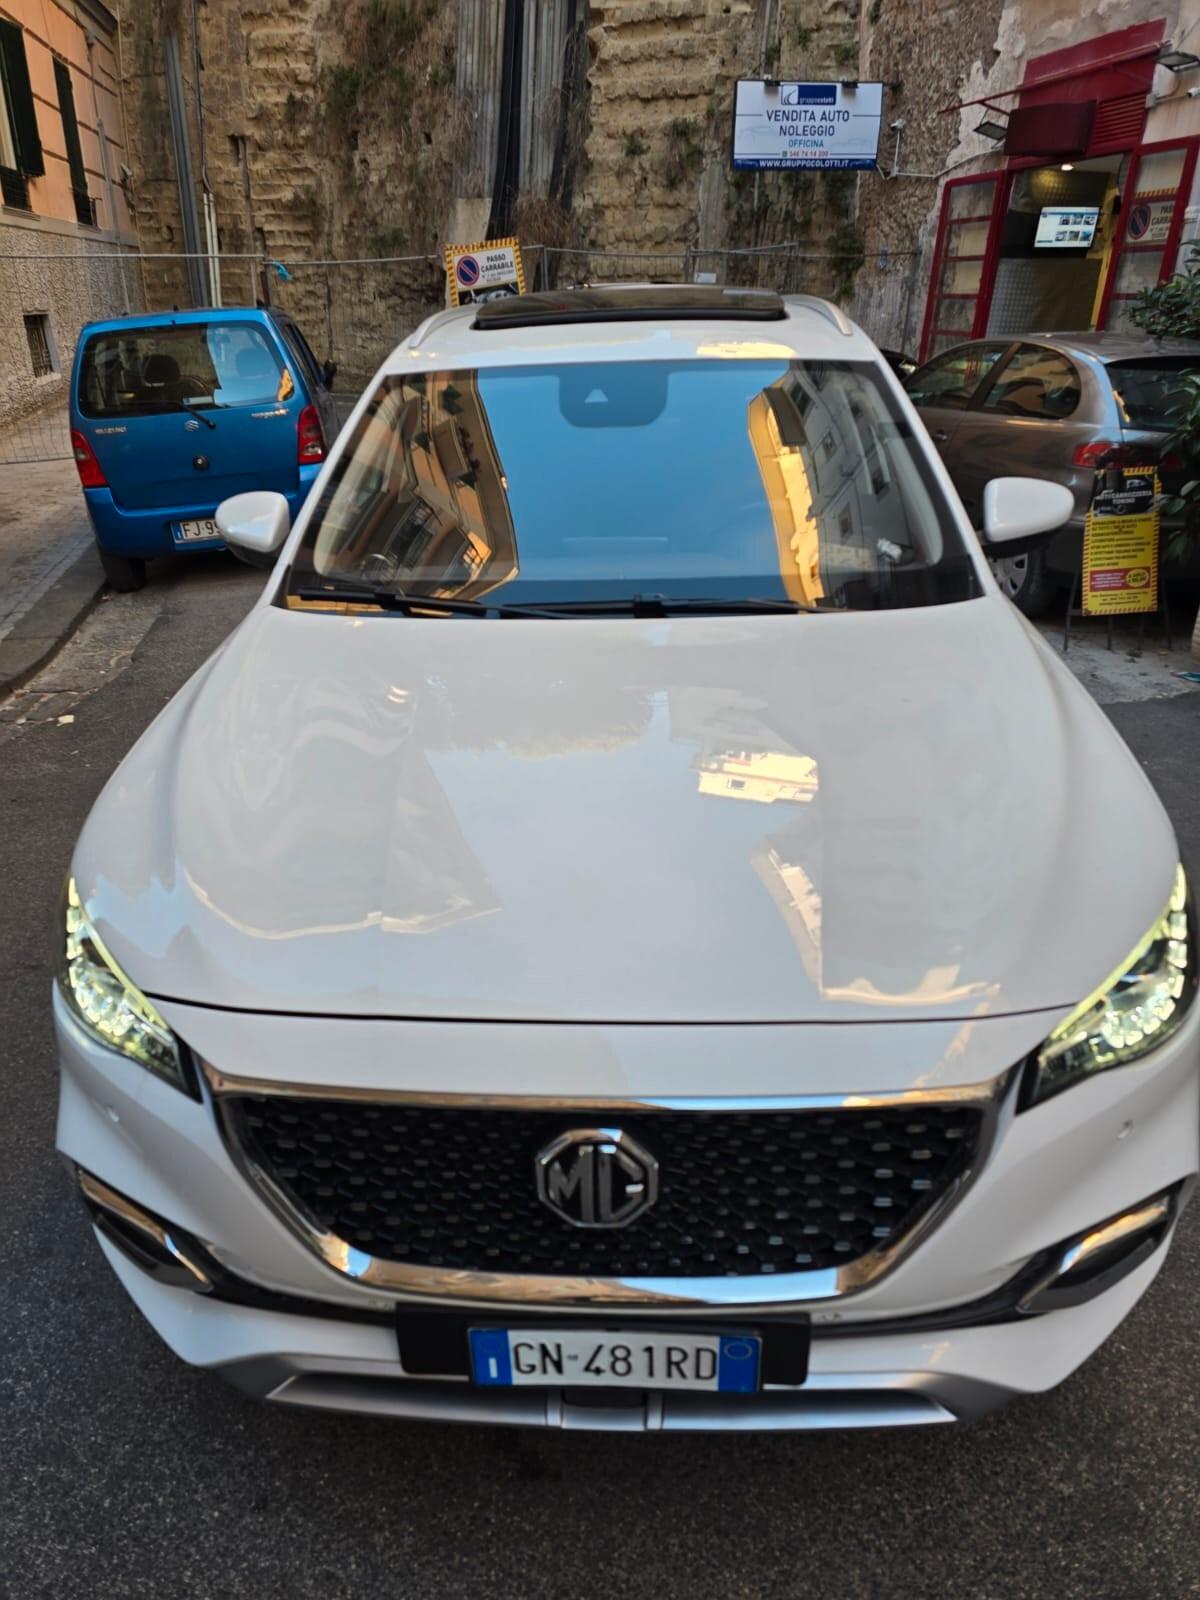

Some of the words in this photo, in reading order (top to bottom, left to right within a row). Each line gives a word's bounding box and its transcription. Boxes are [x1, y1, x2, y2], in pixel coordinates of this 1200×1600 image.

[766, 110, 816, 122] VENDITA
[819, 111, 850, 122] AUTO
[779, 125, 835, 137] NOLEGGIO
[788, 139, 824, 148] OFFICINA
[759, 159, 849, 168] WWW.GRUPPOCOLOTTI.IT
[486, 253, 506, 263] PASSO
[480, 260, 514, 273] CARRABILE
[549, 1145, 644, 1224] MG
